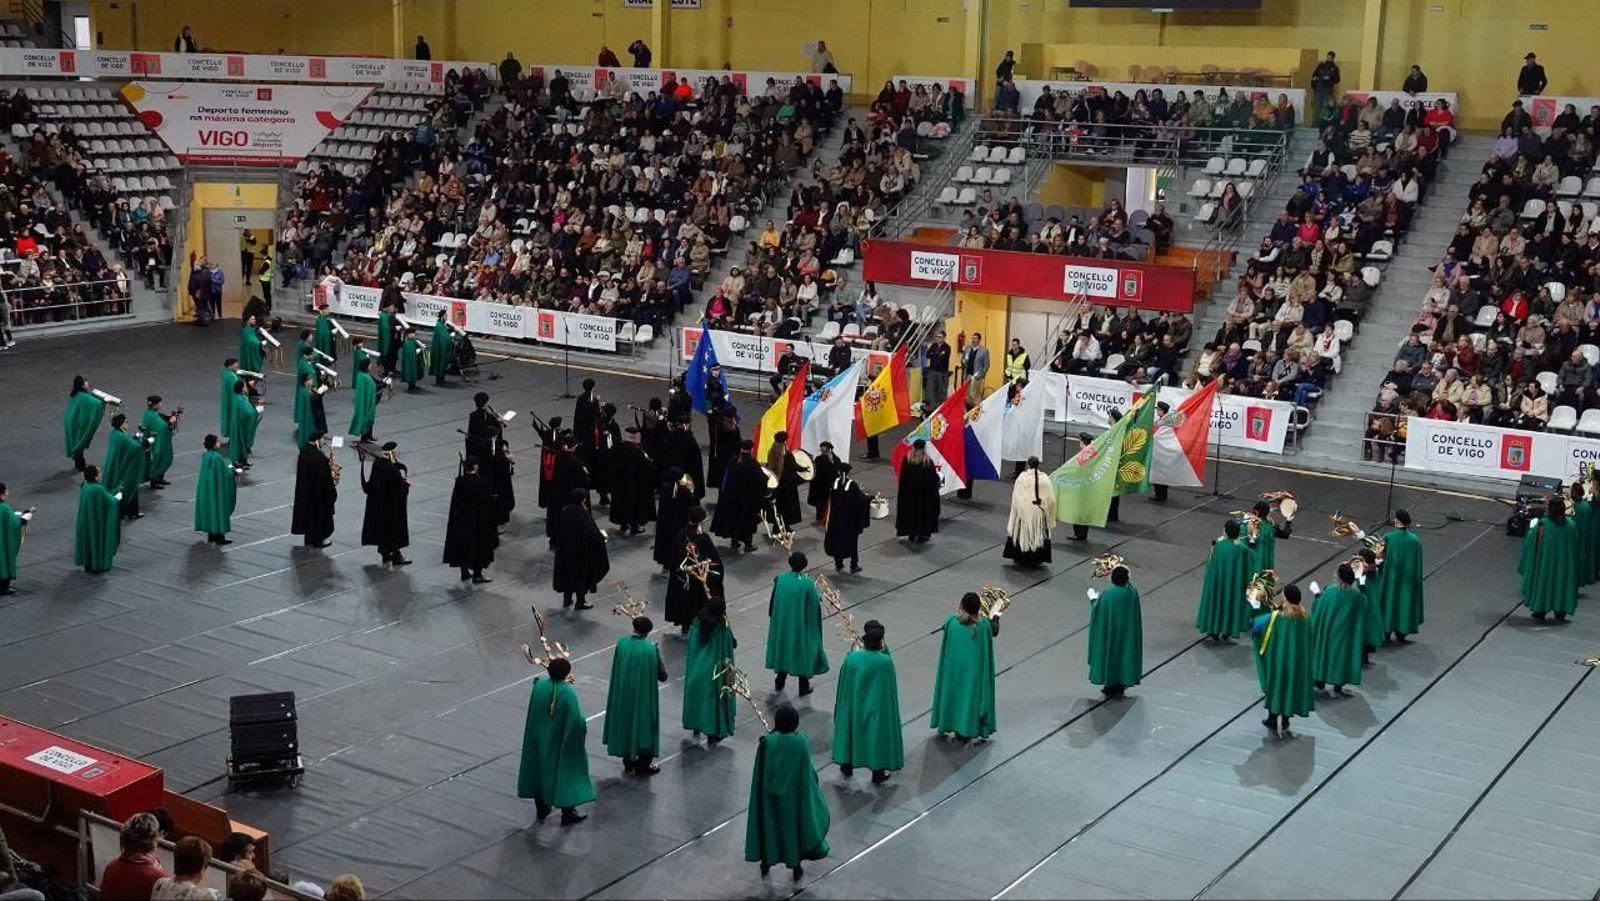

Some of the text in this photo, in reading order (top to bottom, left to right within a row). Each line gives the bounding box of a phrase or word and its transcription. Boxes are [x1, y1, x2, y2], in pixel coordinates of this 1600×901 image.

[198, 106, 289, 115] Deporte femenino
[198, 130, 248, 147] VIGO
[914, 256, 956, 268] CONCELLO
[919, 266, 929, 274] DE
[1068, 271, 1114, 282] CONCELLO
[1087, 282, 1108, 291] VIGO
[348, 293, 377, 302] CONCELLO
[489, 311, 522, 321] CONCELLO
[579, 323, 613, 333] CONCELLO
[594, 332, 610, 341] VIGO
[732, 341, 770, 352] CONCELLO
[748, 352, 765, 361] VIGO
[1076, 391, 1126, 405] CONCELLO
[1080, 402, 1092, 410] DE
[1432, 434, 1493, 448] CONCELLO
[1438, 446, 1485, 459] DE VIGO
